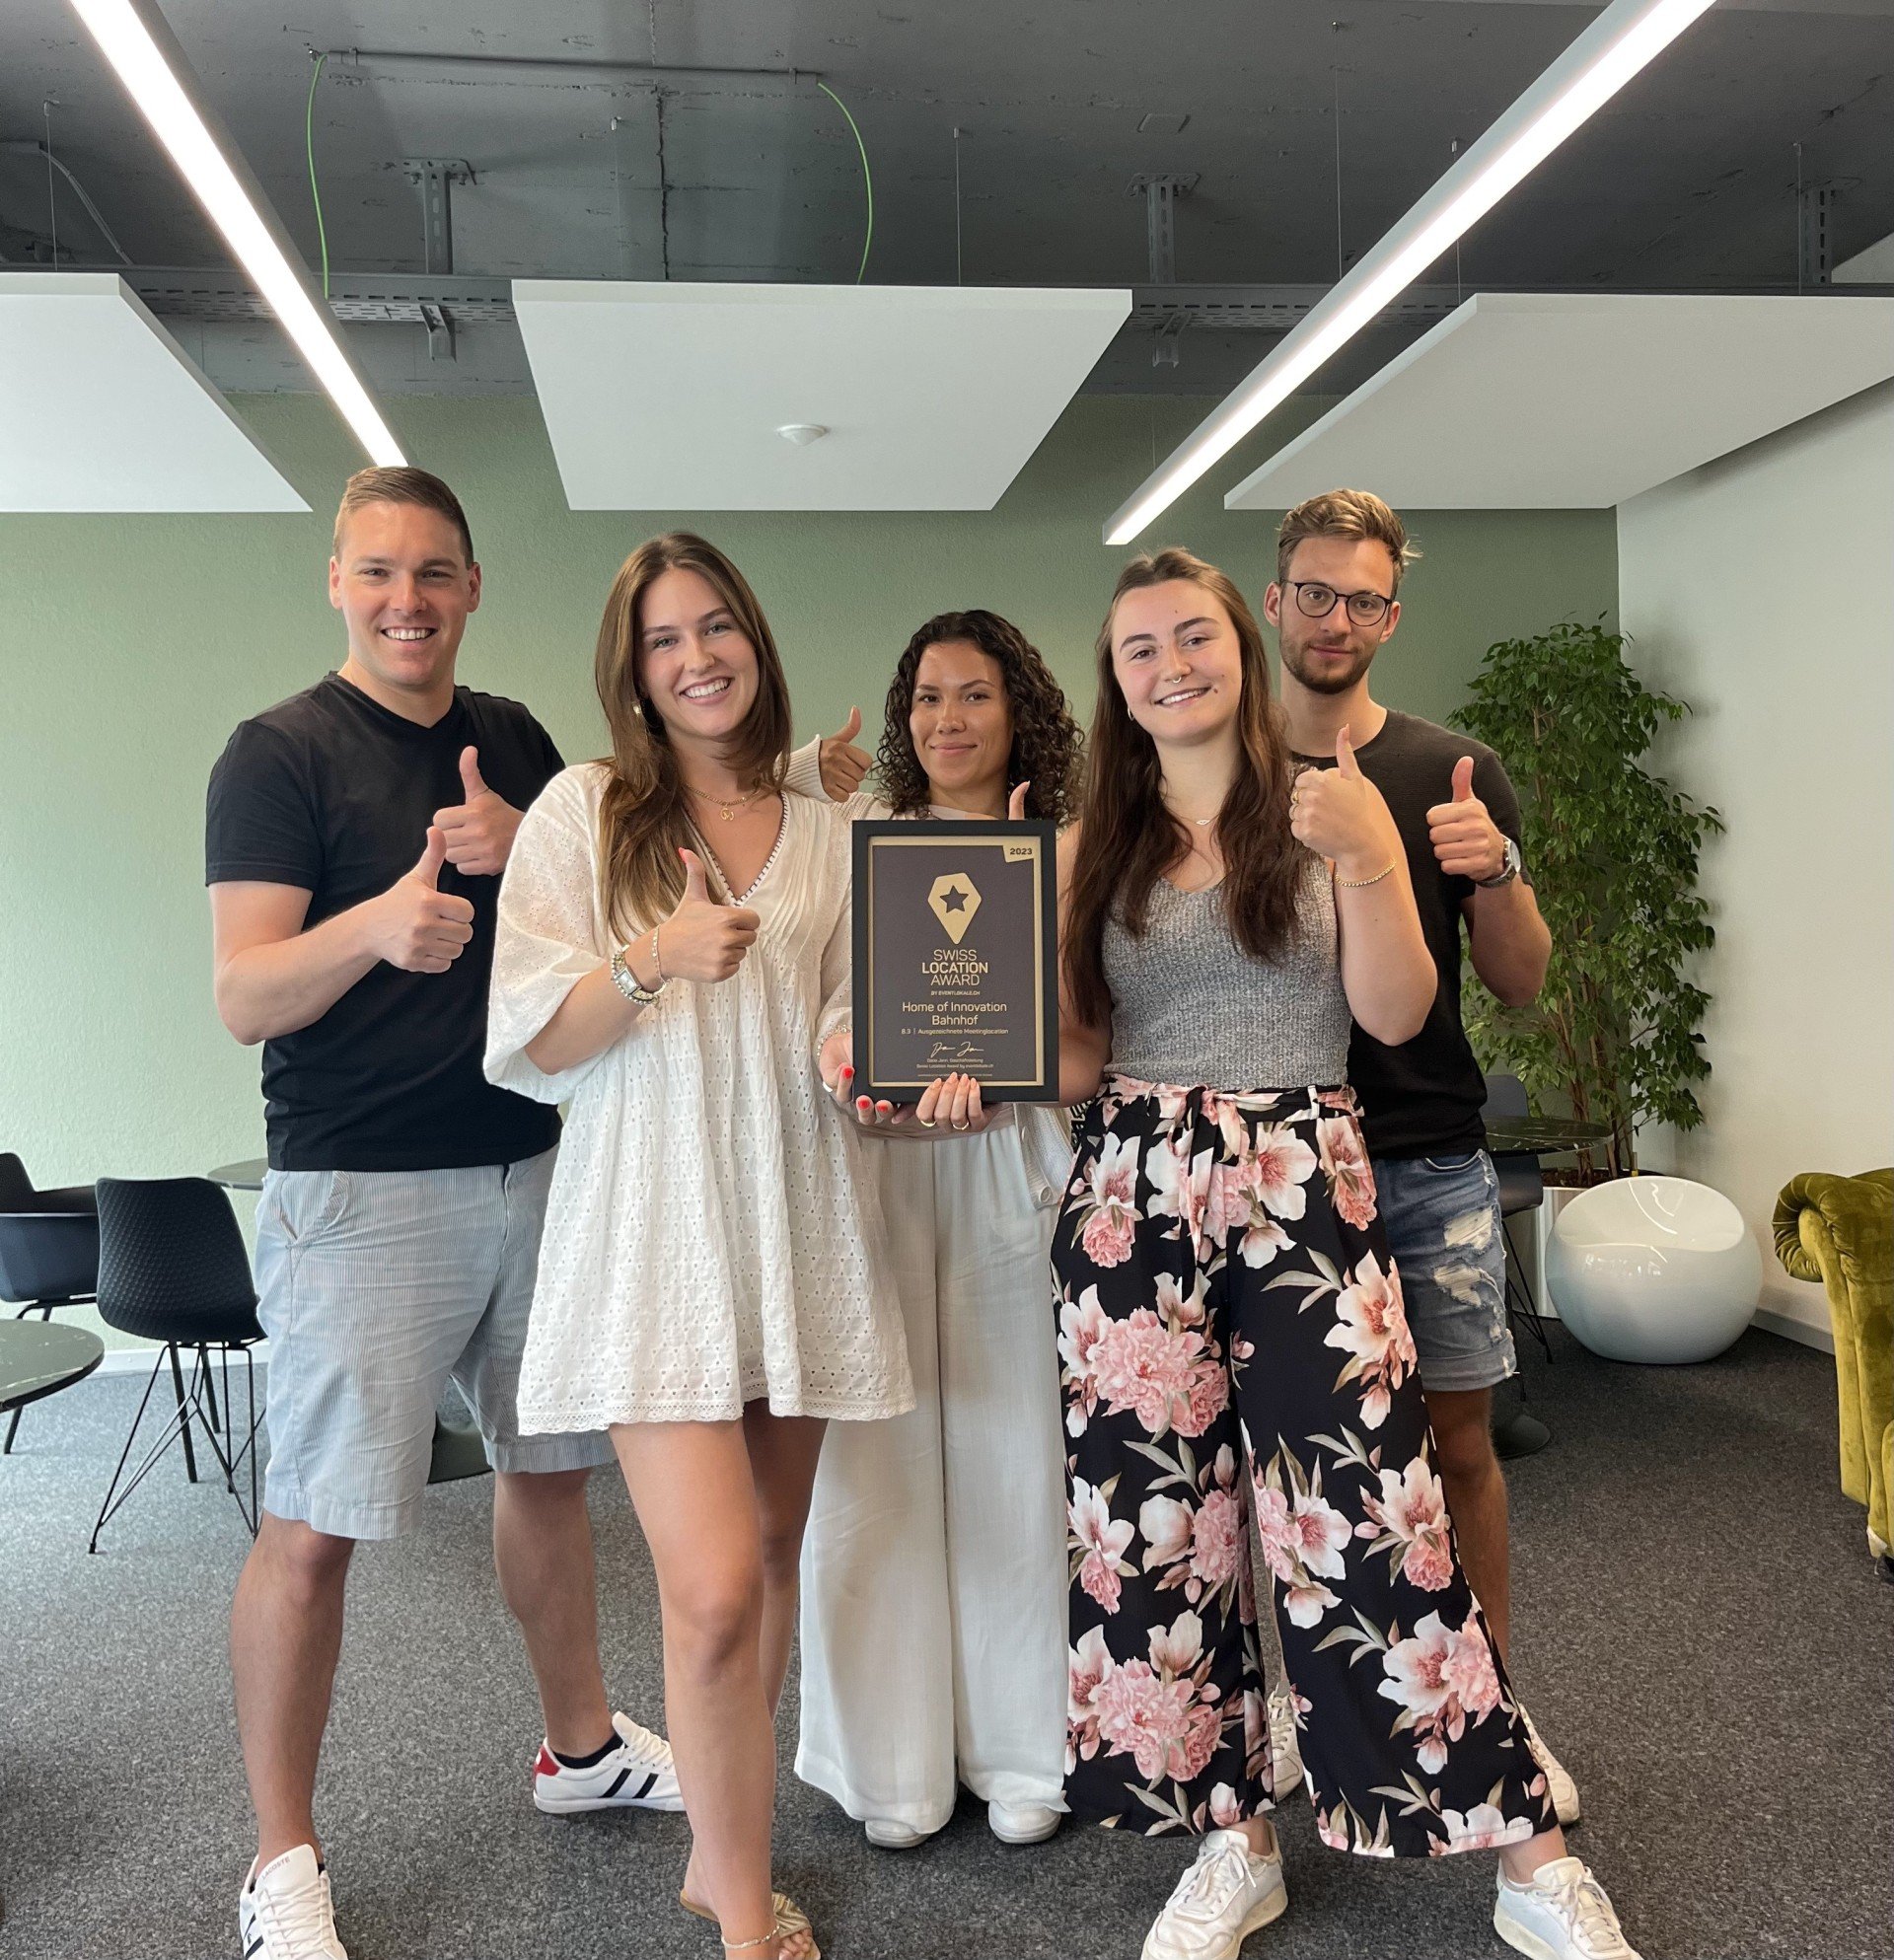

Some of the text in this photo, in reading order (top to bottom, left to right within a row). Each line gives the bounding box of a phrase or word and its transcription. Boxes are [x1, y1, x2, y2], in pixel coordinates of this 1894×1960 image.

[933, 949, 977, 961] SWISS
[922, 962, 988, 974] LOCATION
[930, 974, 980, 986] AWARD
[902, 1001, 1007, 1012] Home of Innovation
[932, 1015, 979, 1025] Bahnhof
[261, 1856, 291, 1880] LACOSTE
